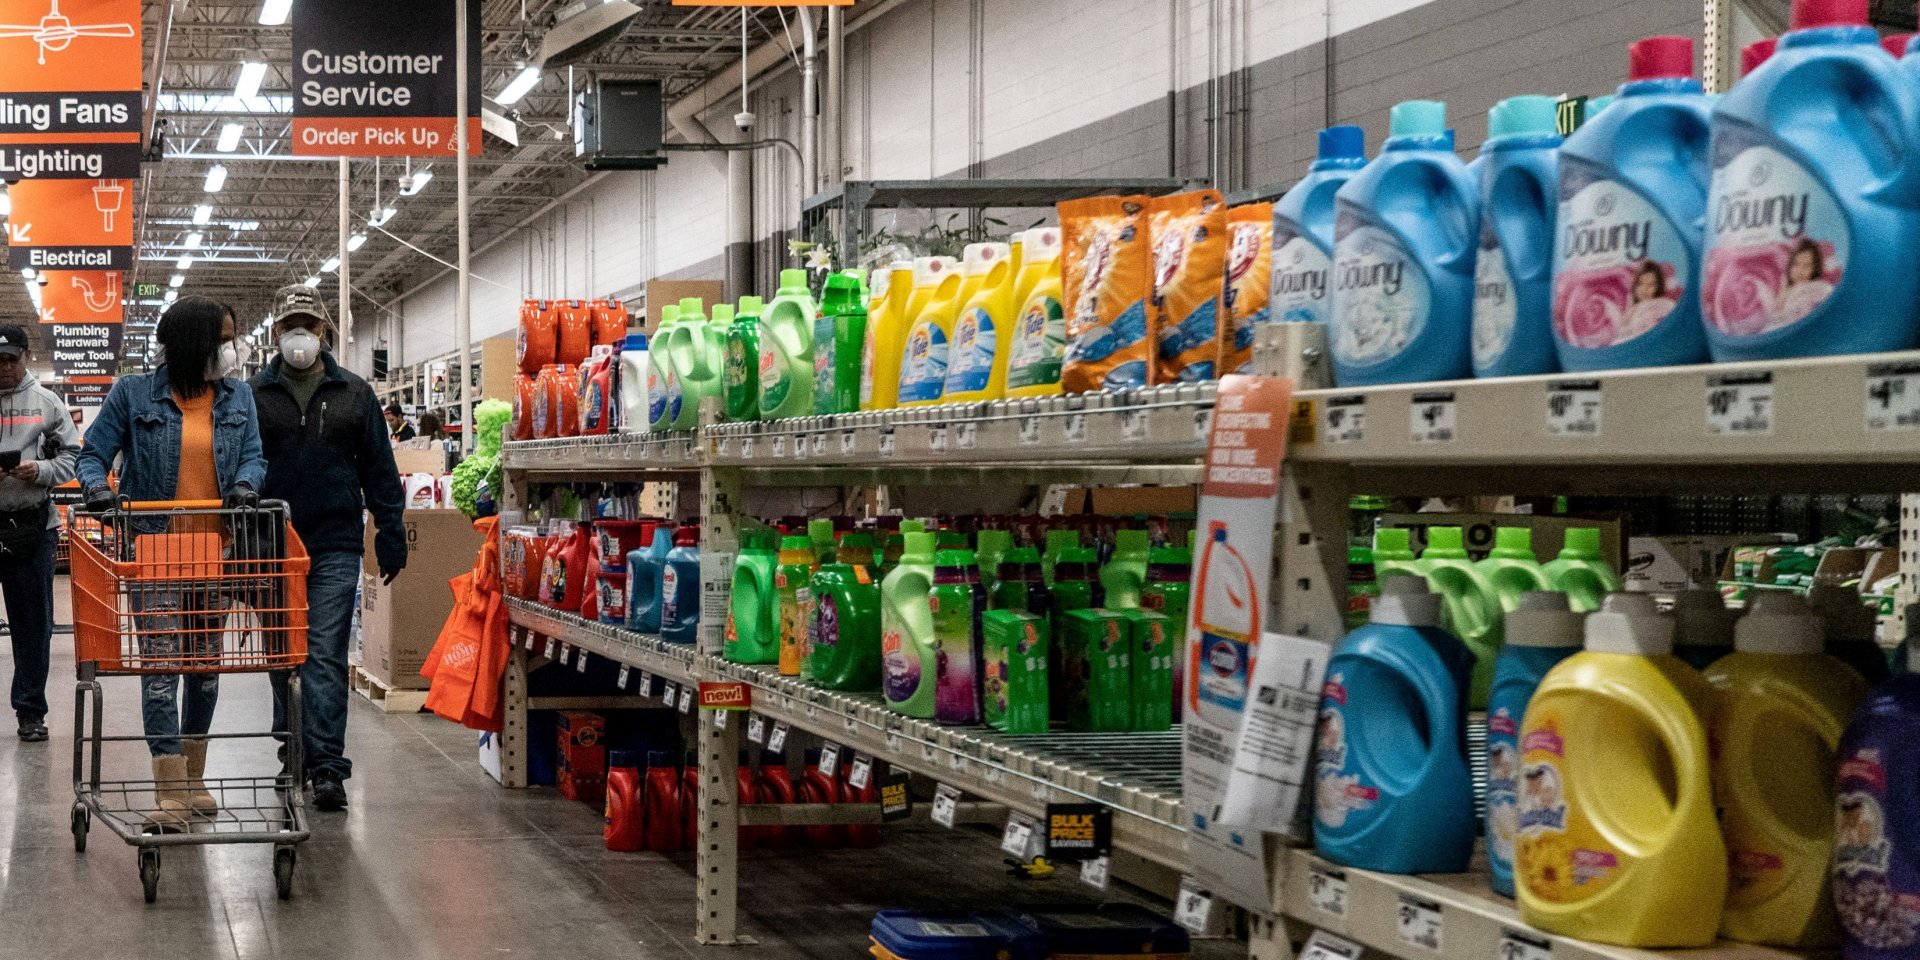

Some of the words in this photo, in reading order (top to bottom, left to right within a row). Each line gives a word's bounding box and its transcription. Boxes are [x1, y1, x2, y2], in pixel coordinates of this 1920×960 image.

[302, 49, 443, 75] Customer
[302, 81, 411, 106] Service
[59, 98, 129, 124] Fans
[1556, 100, 1577, 135] XIT
[302, 128, 358, 146] Order
[364, 128, 406, 146] Pick
[412, 129, 440, 149] Up
[0, 149, 102, 177] Lighting
[1713, 189, 1810, 238] Downy
[1563, 218, 1651, 261] Downy
[30, 250, 112, 266] Electrical
[138, 284, 157, 296] EXIT
[53, 325, 110, 338] Plumbing
[1024, 313, 1044, 338] Tide
[56, 338, 109, 348] Hardware
[54, 351, 86, 361] Power
[88, 351, 115, 361] Tools
[704, 687, 742, 703] new!
[1051, 814, 1094, 828] BULK
[1051, 828, 1094, 840] PRICE
